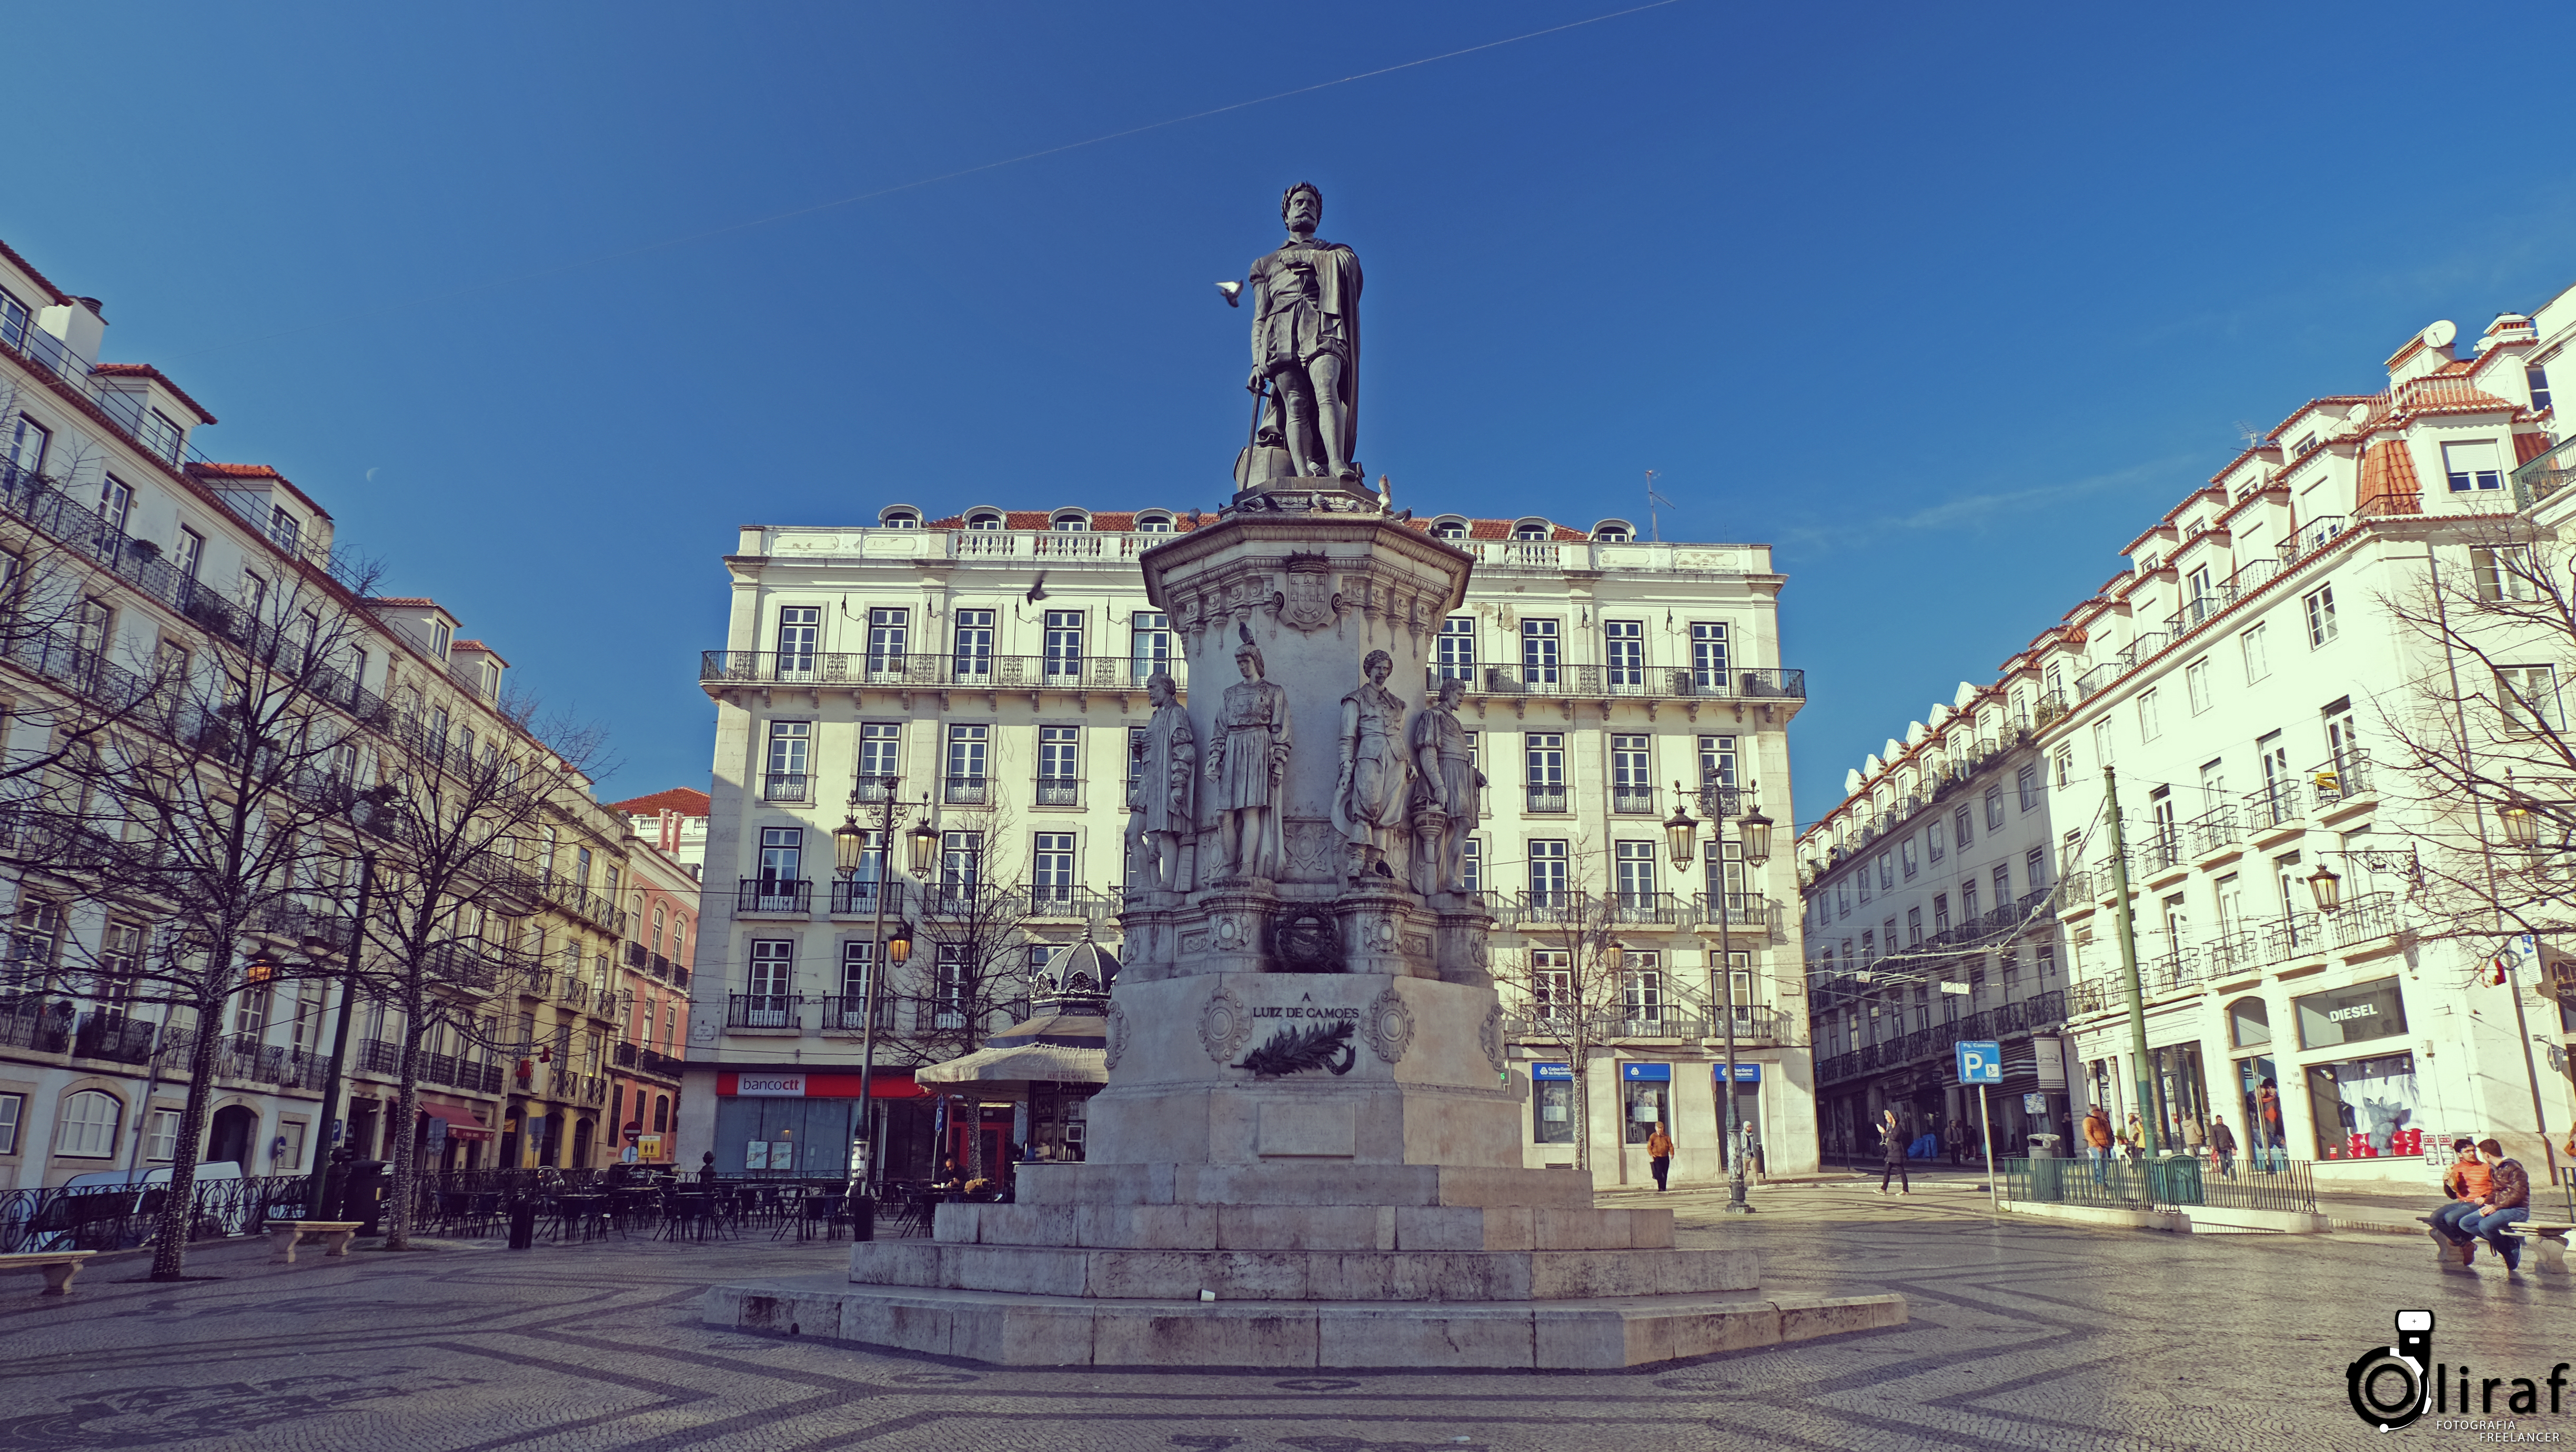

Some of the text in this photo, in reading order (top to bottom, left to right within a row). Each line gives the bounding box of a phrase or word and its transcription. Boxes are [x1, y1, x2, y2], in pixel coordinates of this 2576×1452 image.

[1302, 992, 1311, 1002] A
[1253, 1007, 1283, 1017] LUIZ
[1286, 1007, 1303, 1018] DE
[2329, 1003, 2378, 1022] DIESEL
[1964, 1053, 1983, 1077] P
